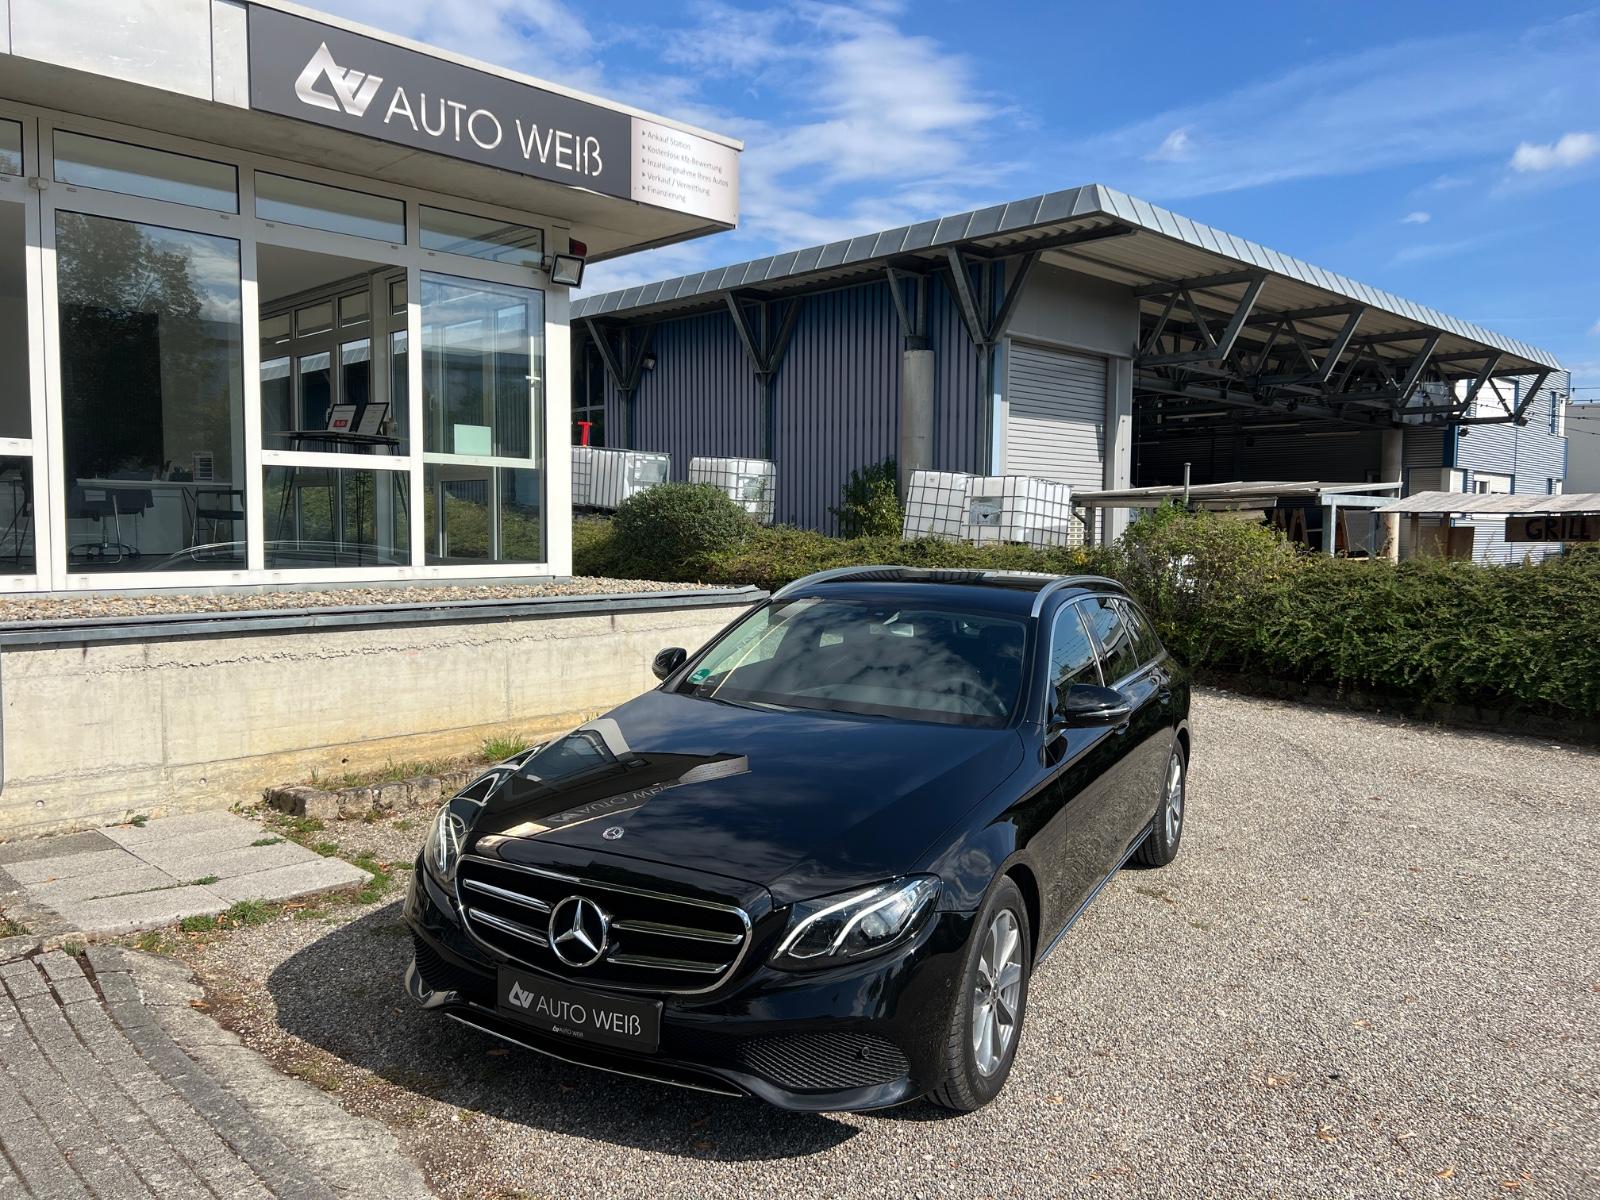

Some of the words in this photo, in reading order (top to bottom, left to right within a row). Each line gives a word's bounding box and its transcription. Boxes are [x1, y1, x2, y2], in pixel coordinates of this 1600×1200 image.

[384, 86, 502, 150] AUTO
[515, 119, 603, 177] WEIß
[647, 131, 669, 142] Ankauf
[670, 137, 691, 150] Station
[647, 146, 680, 161] Kostenlose
[647, 173, 671, 185] Verkauf
[712, 176, 729, 187] Autos
[647, 186, 686, 203] Finanzierung
[1525, 517, 1591, 540] GRILL
[536, 995, 587, 1024] AUTO
[592, 1008, 641, 1036] WEIß
